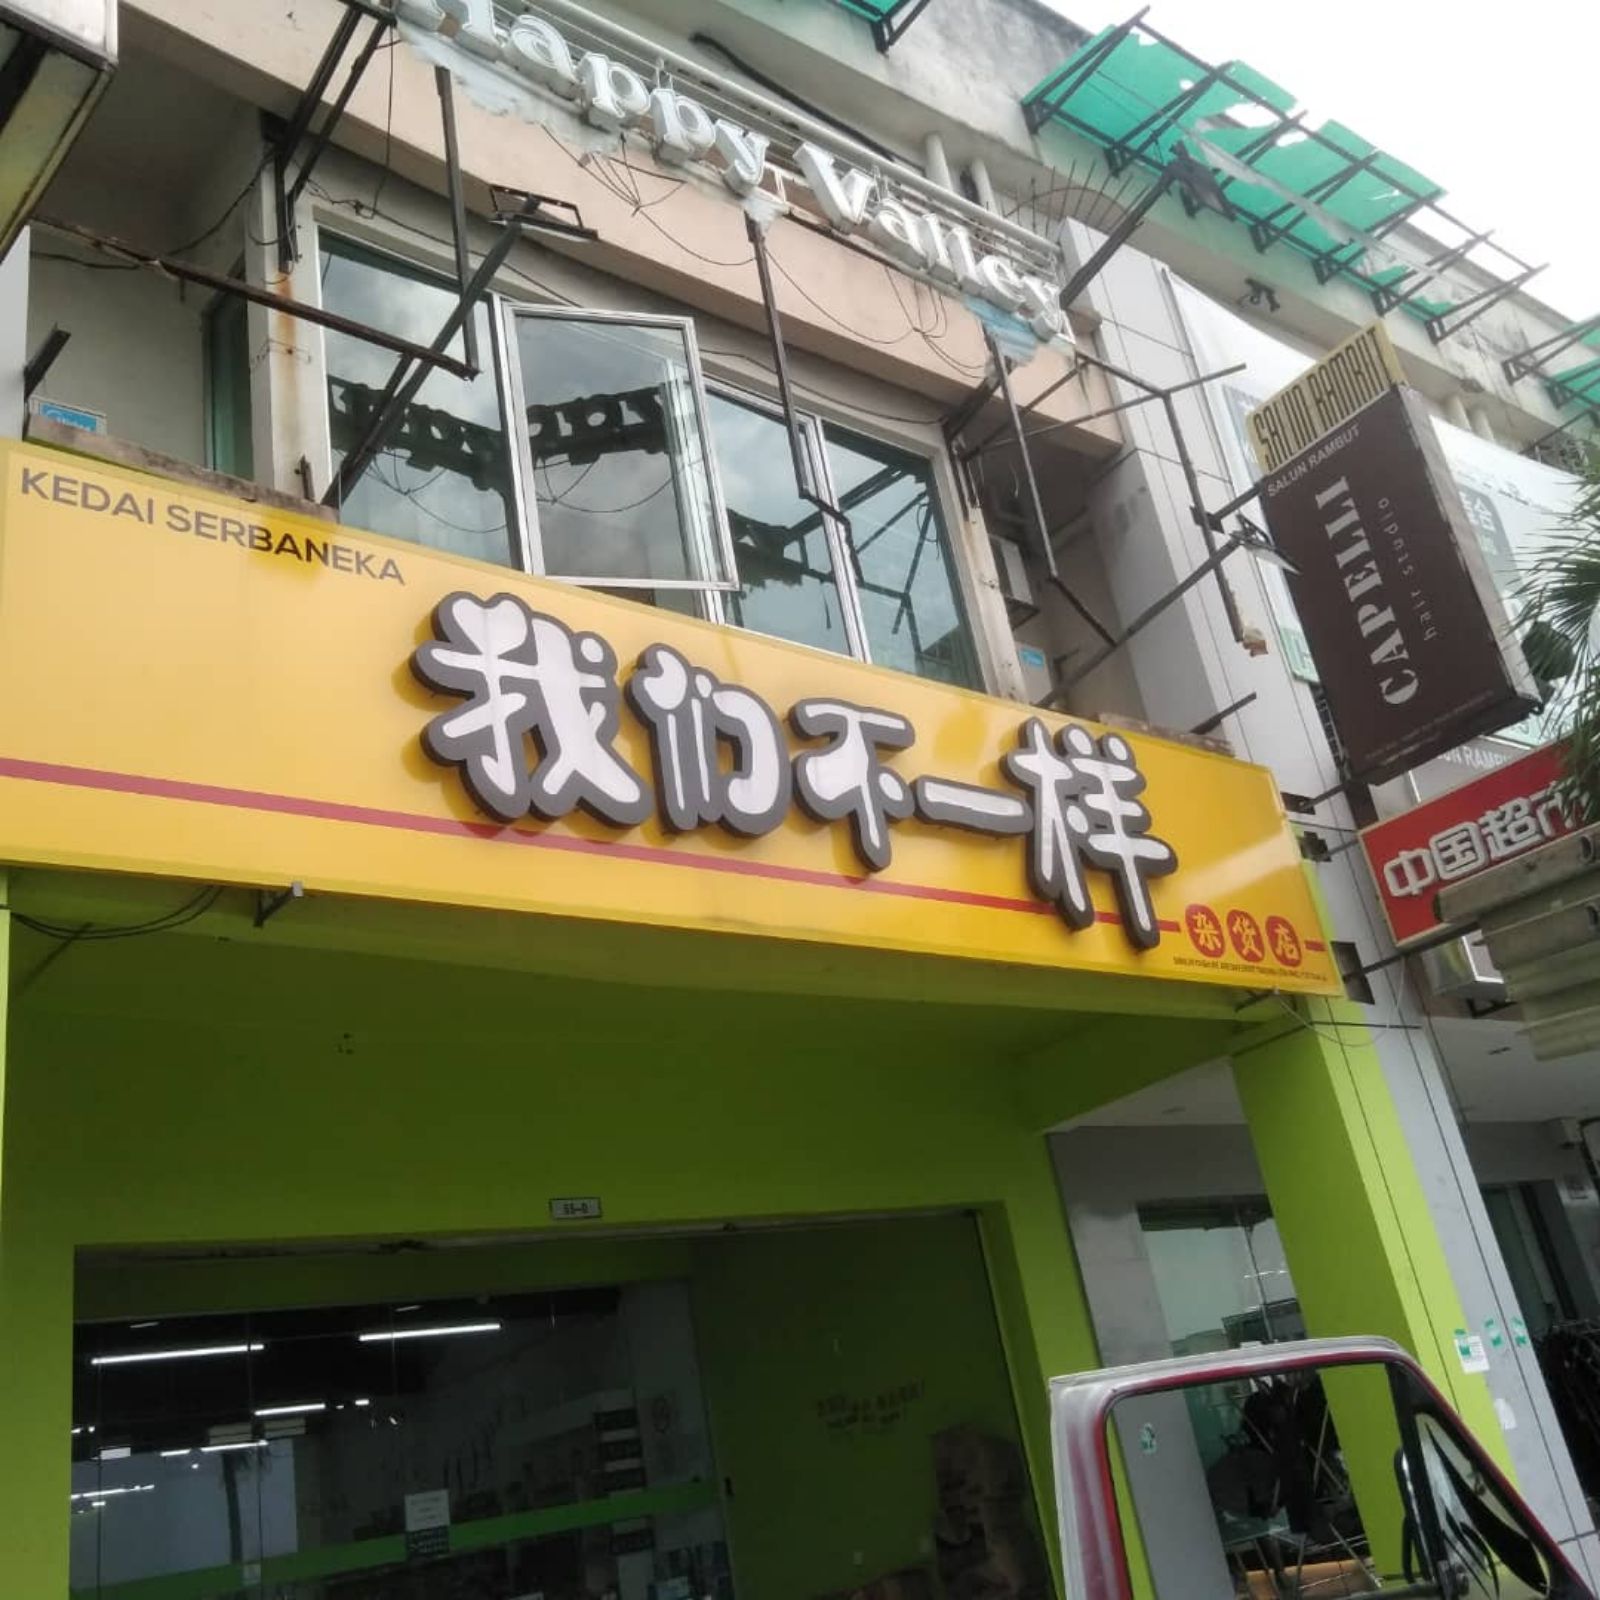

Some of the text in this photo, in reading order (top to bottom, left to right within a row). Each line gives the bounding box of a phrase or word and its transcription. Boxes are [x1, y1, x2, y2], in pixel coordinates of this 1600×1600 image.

[793, 142, 1063, 341] Valley
[21, 466, 406, 586] KEDAI SERBANEKA
[1267, 423, 1361, 497] SALUN RAMBUT
[1377, 497, 1414, 576] studio
[1315, 476, 1420, 706] CAPELLI
[411, 590, 1178, 950] 我们不一样
